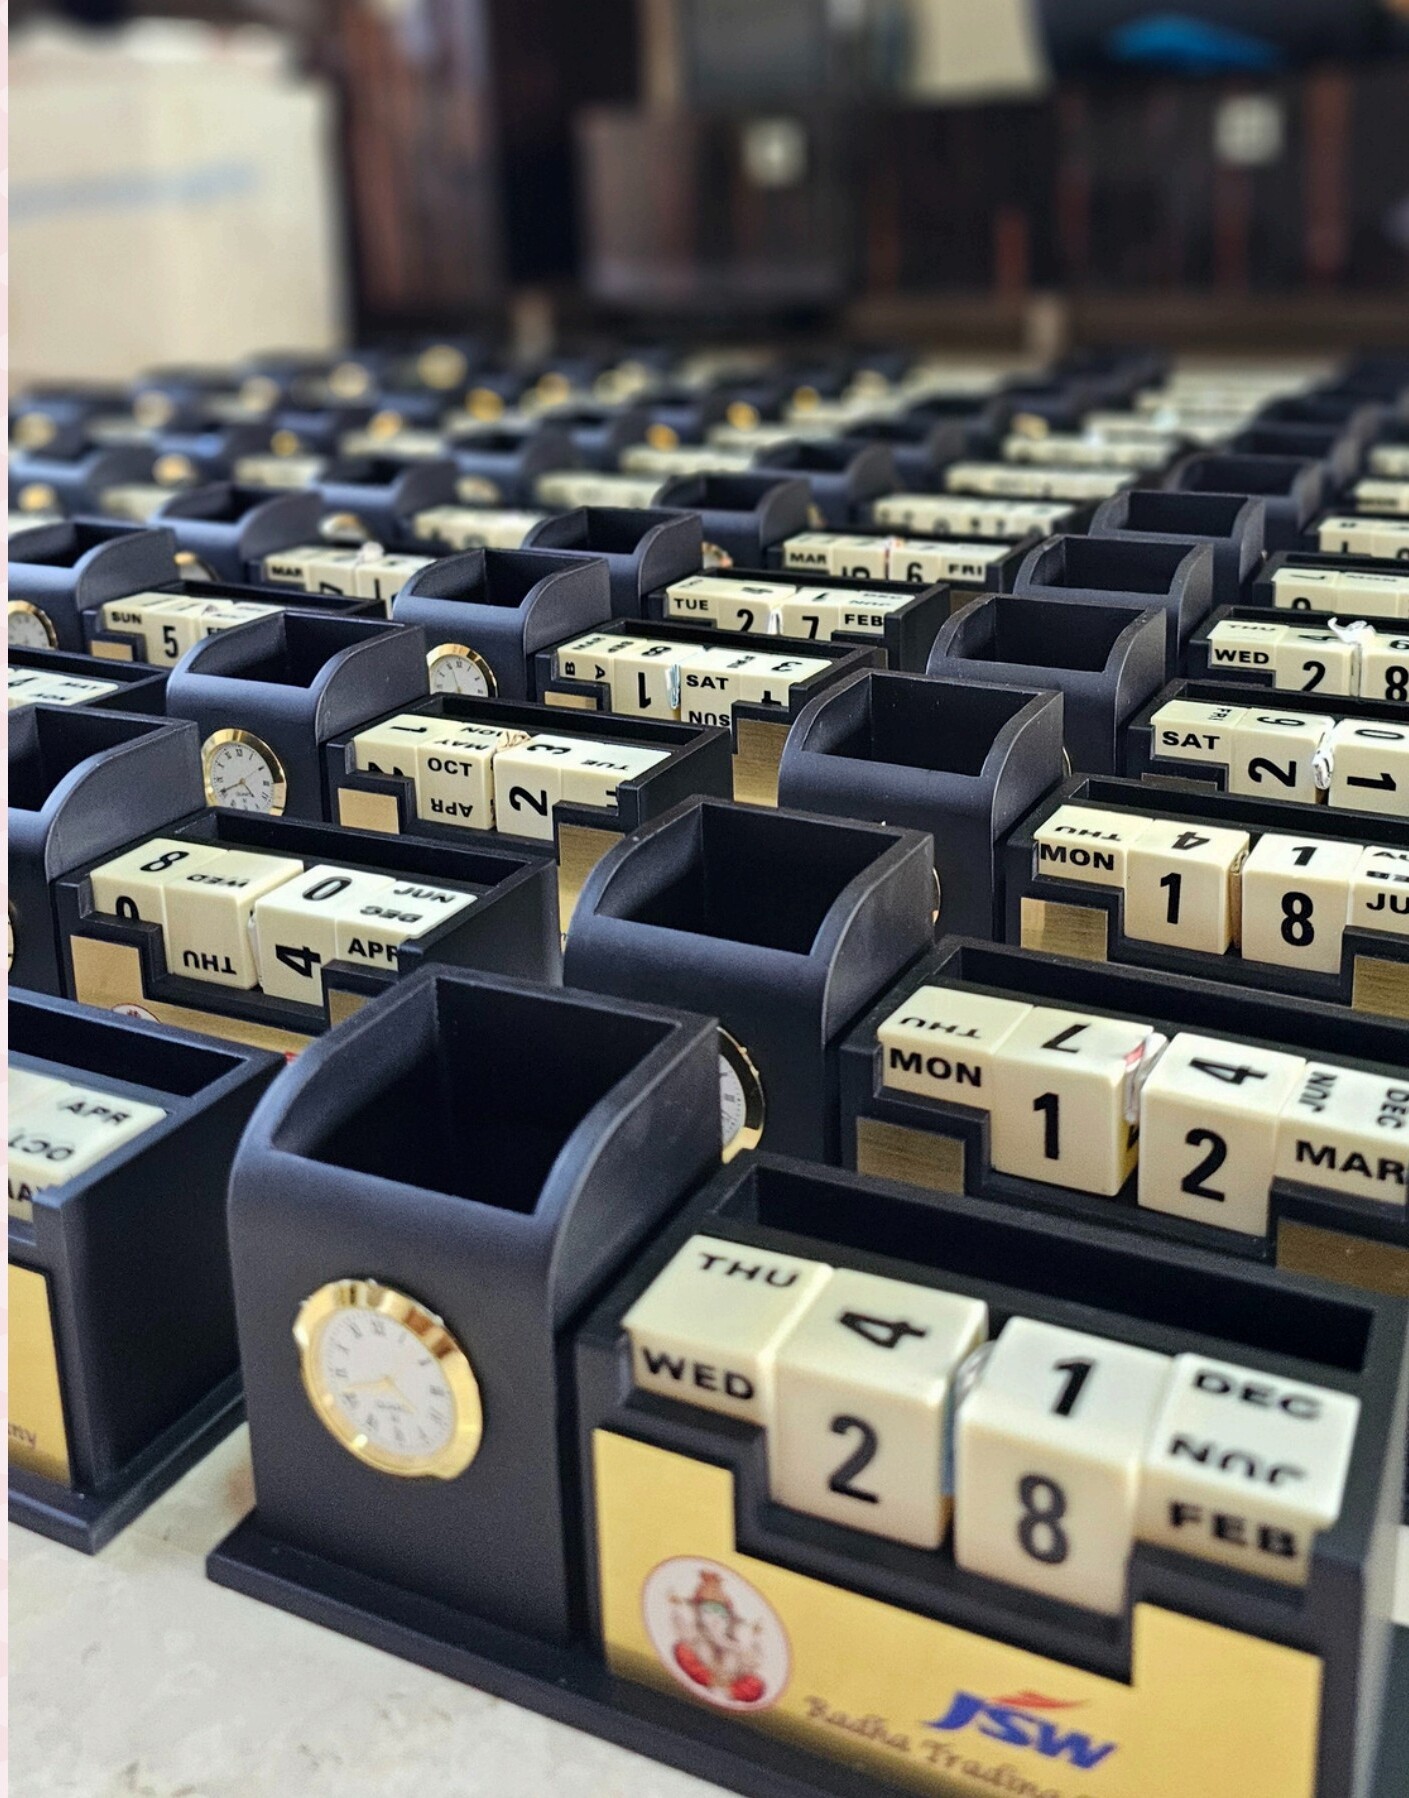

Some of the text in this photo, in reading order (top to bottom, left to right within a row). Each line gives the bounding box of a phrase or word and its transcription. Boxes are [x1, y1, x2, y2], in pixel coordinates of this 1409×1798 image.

[789, 552, 828, 565] MAR
[948, 563, 983, 576] FRI
[111, 611, 179, 658] SUN 5
[673, 597, 883, 640] TUE 2 7 FEB
[638, 672, 729, 709] 1 SAT
[1214, 648, 1409, 701] WED 2 8
[1162, 731, 1220, 750] SAT
[1248, 757, 1297, 788] 2
[428, 758, 473, 777] OCT
[509, 785, 548, 817] 2
[430, 798, 473, 818] APR
[1054, 826, 1122, 842] THU
[1171, 831, 1210, 850] 4
[1292, 846, 1318, 866] 1
[140, 850, 456, 904] 8 0 JUN
[1040, 843, 1115, 871] MON
[1160, 872, 1182, 925] 1
[1280, 891, 1315, 947] 8
[183, 950, 237, 975] THU
[275, 943, 321, 978] 4
[900, 1016, 982, 1041] THU
[1189, 1057, 1268, 1085] 4
[1299, 1071, 1338, 1113] JUN
[1377, 1087, 1409, 1128] DEC
[890, 1048, 982, 1087] MON
[1033, 1092, 1060, 1160] 1
[1181, 1129, 1227, 1202] 2
[1295, 1139, 1406, 1185] MAR
[699, 1253, 1323, 1421] THU 4 1 DEC
[641, 1348, 1298, 1565] WED 2 8 FEB
[1171, 1434, 1306, 1484] JUN
[921, 1691, 1117, 1769] JSW
